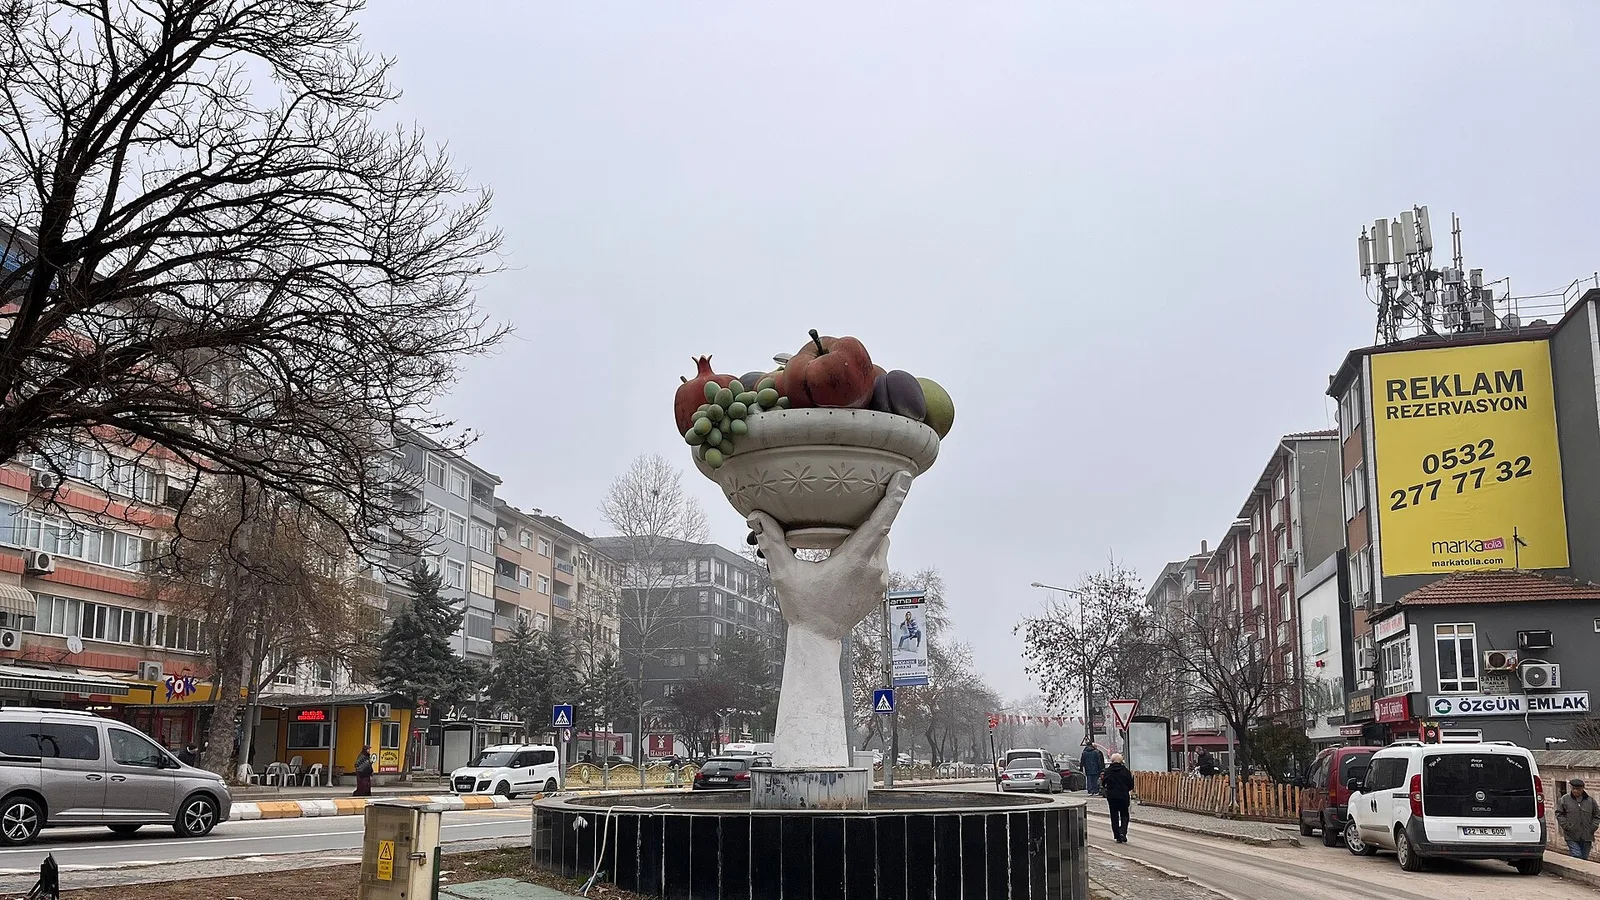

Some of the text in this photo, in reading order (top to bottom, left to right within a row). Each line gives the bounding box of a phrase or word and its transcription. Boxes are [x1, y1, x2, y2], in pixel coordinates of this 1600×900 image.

[1386, 369, 1525, 402] REKLAM
[1386, 396, 1528, 420] REZERVASYON
[1422, 438, 1495, 475] 0532
[1390, 456, 1532, 511] 277 77 32
[1458, 696, 1587, 712] ÖZGÜN EMLAK
